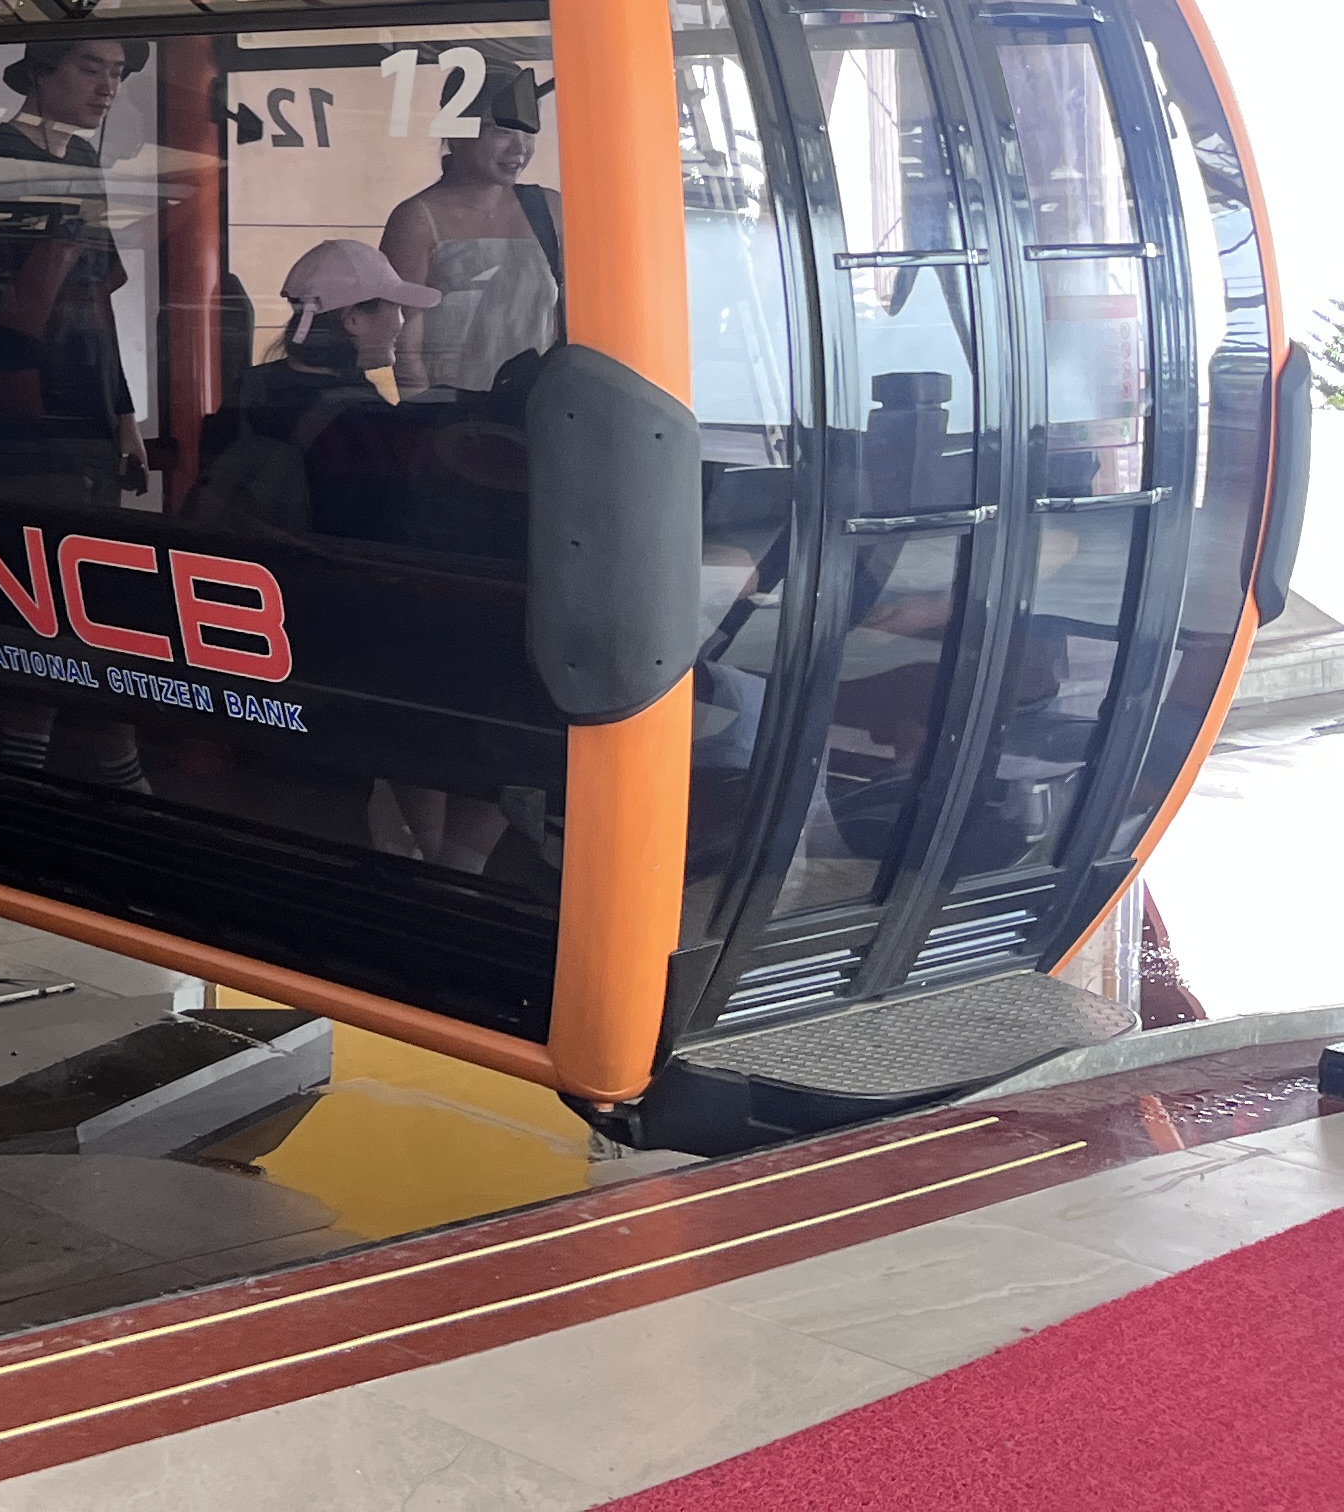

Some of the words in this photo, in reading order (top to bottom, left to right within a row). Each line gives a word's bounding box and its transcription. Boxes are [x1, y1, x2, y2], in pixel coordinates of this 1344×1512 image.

[378, 45, 487, 140] 12
[106, 666, 214, 713] CITIZEN
[223, 689, 308, 733] BANK
